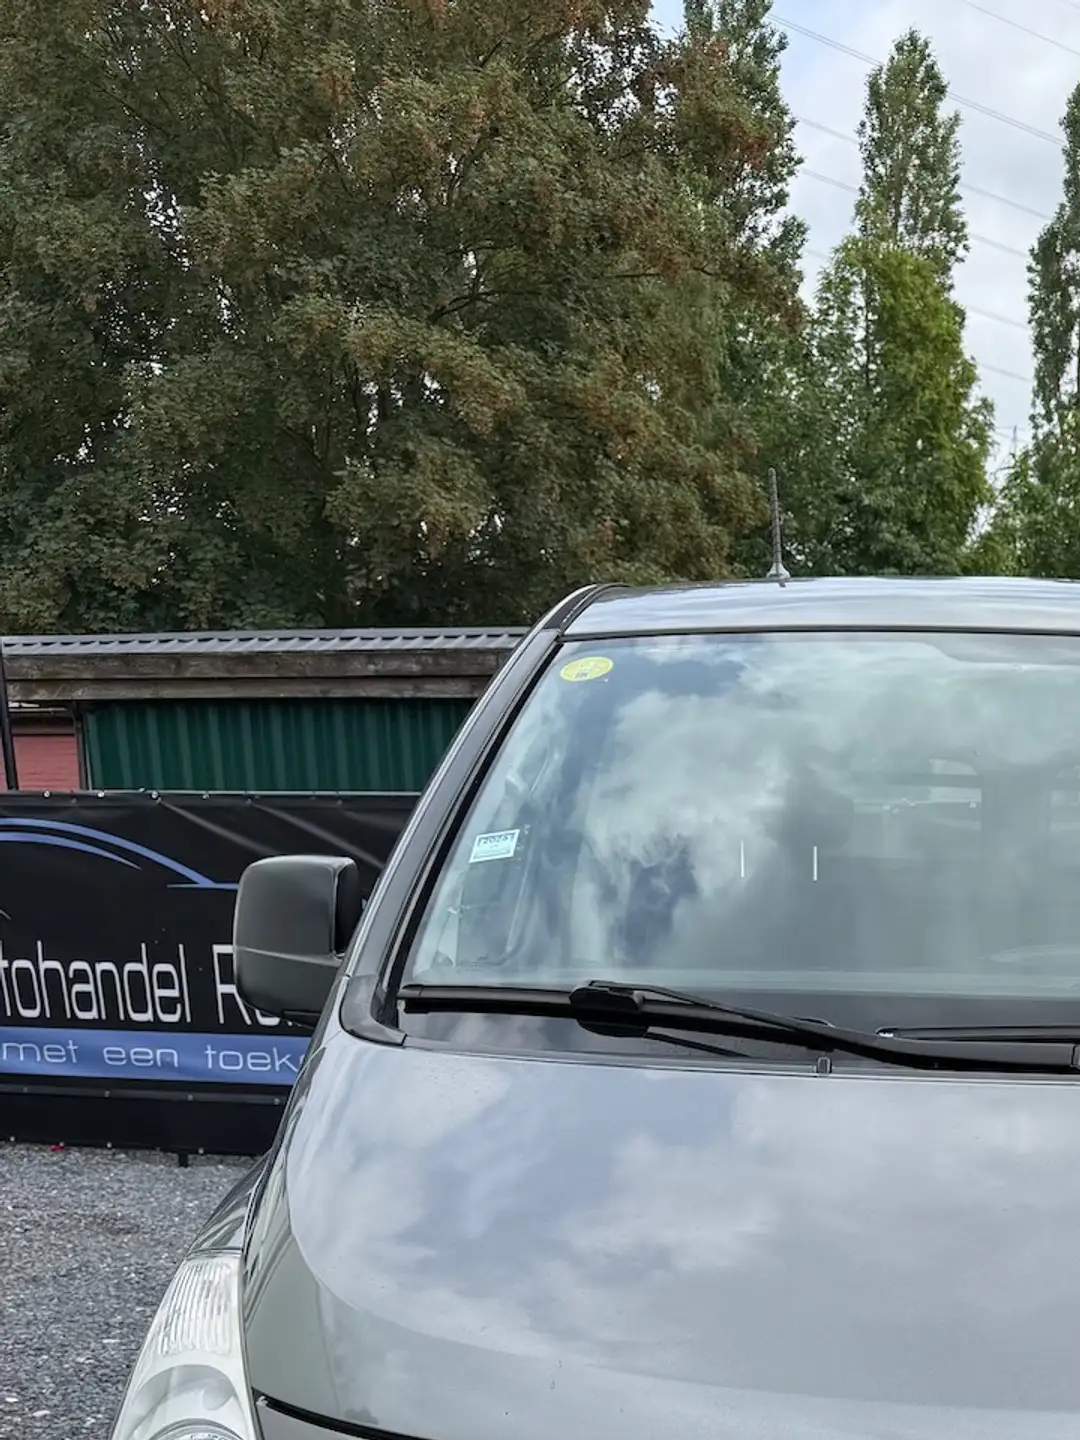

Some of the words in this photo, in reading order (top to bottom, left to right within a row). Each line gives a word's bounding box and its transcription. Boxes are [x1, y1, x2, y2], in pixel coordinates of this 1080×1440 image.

[2, 1040, 79, 1063] met
[103, 1047, 179, 1068] een
[204, 1044, 305, 1072] toek
